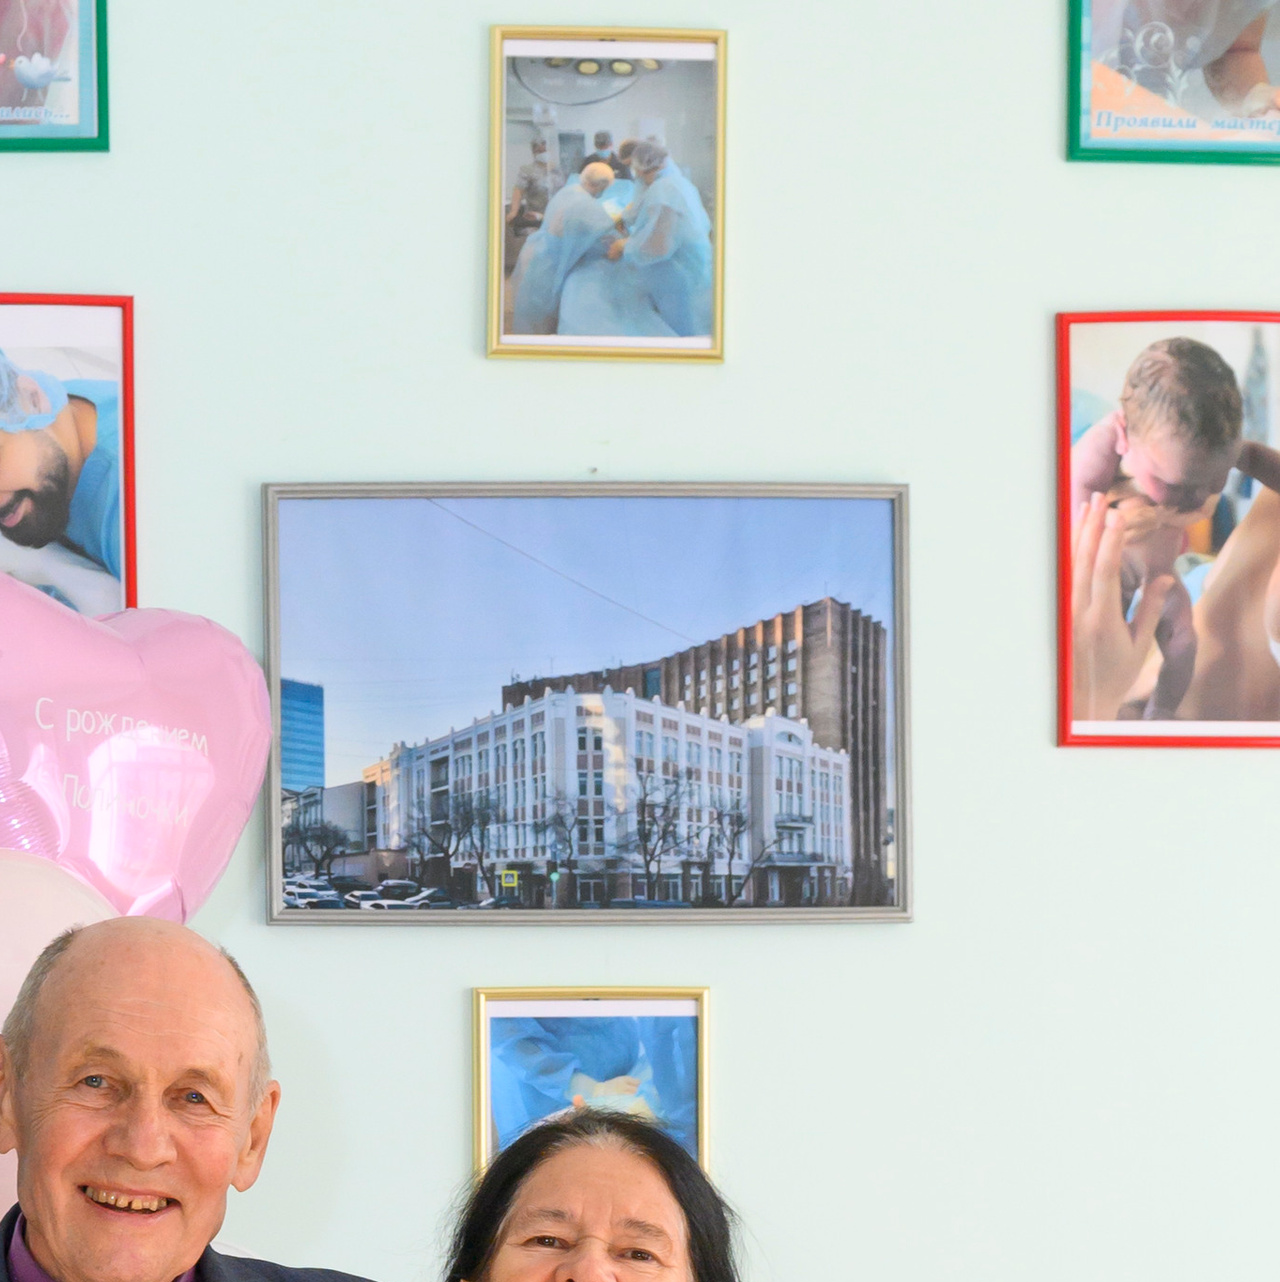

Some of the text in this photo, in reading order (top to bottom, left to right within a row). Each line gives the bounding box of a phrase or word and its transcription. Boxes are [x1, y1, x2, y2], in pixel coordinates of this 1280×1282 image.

[1096, 110, 1198, 133] Проявили
[34, 697, 209, 757] С рождением
